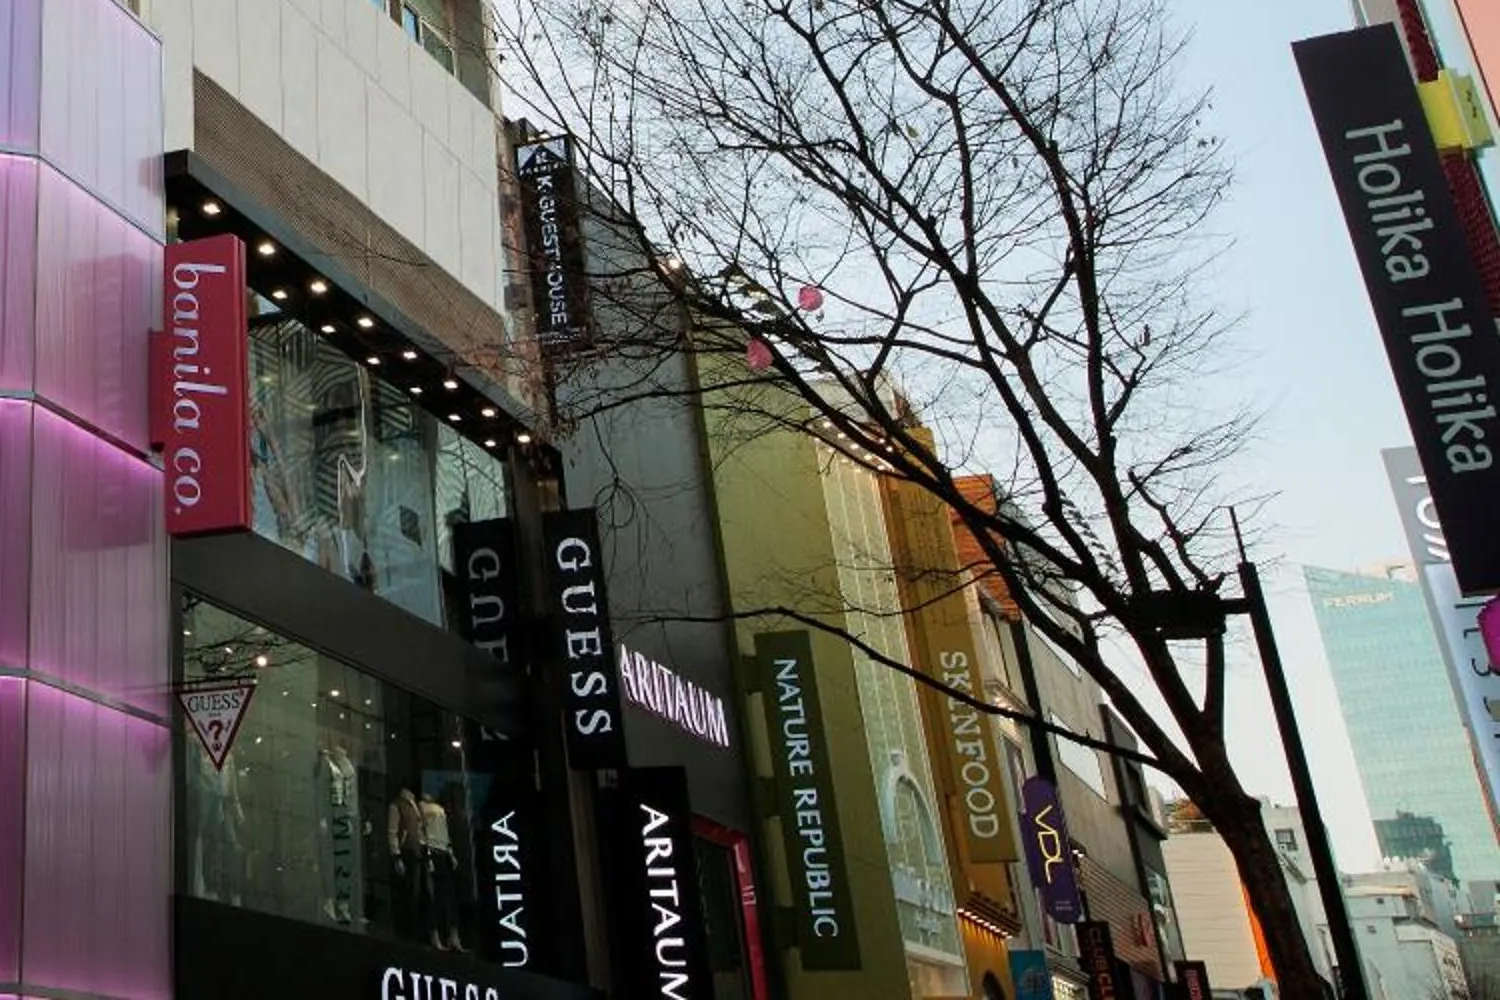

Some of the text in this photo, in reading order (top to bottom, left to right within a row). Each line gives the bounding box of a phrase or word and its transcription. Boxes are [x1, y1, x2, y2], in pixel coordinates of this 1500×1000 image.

[173, 263, 228, 515] banila co.
[1345, 119, 1434, 282] Holika
[1402, 297, 1497, 473] Holika
[187, 692, 240, 713] GUESS
[556, 537, 613, 736] GUESS
[620, 643, 730, 748] ARITAUM
[773, 659, 838, 937] NATURE REPUBLIC
[1035, 805, 1063, 883] VDL
